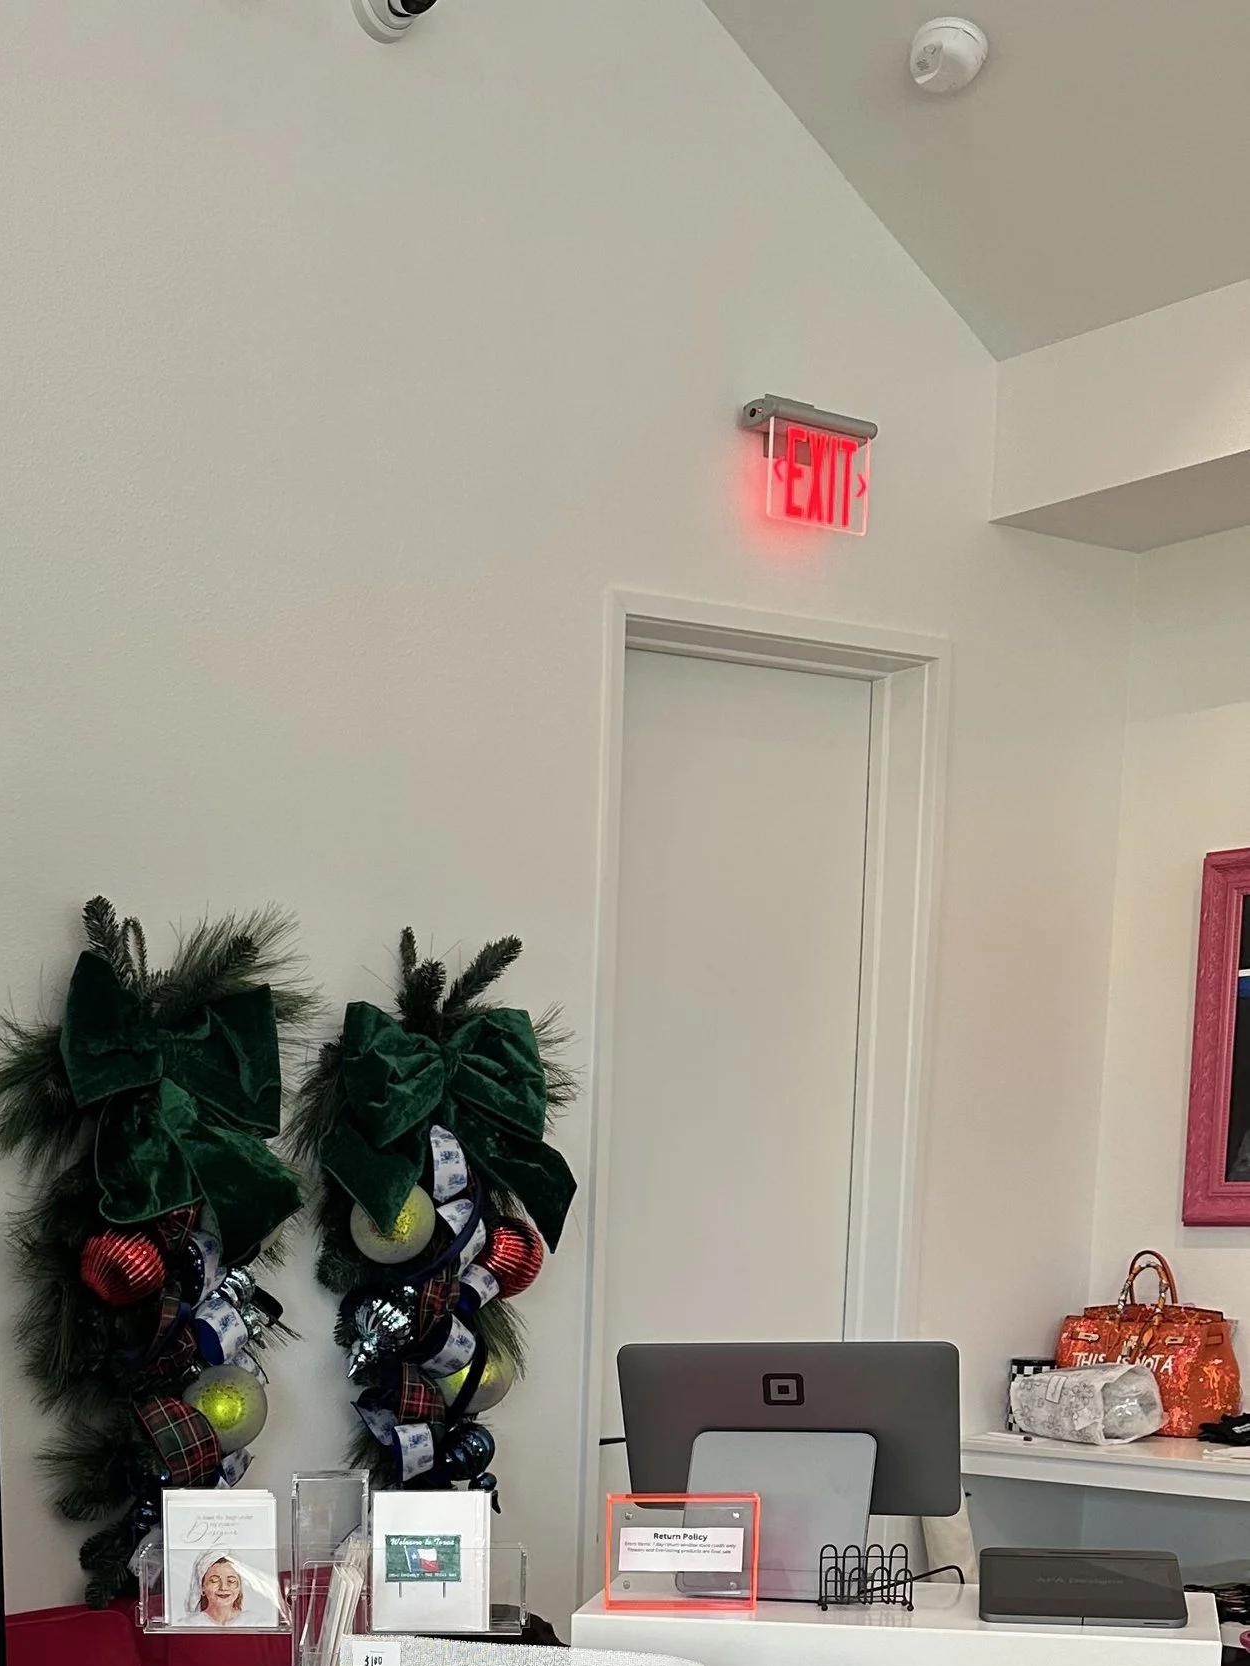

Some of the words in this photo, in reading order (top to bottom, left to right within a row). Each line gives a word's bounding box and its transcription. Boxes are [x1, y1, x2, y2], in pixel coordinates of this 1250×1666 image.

[785, 426, 858, 528] EXIT
[1072, 1352, 1106, 1367] THIS
[653, 1532, 680, 1540] Return
[683, 1533, 708, 1542] Policy
